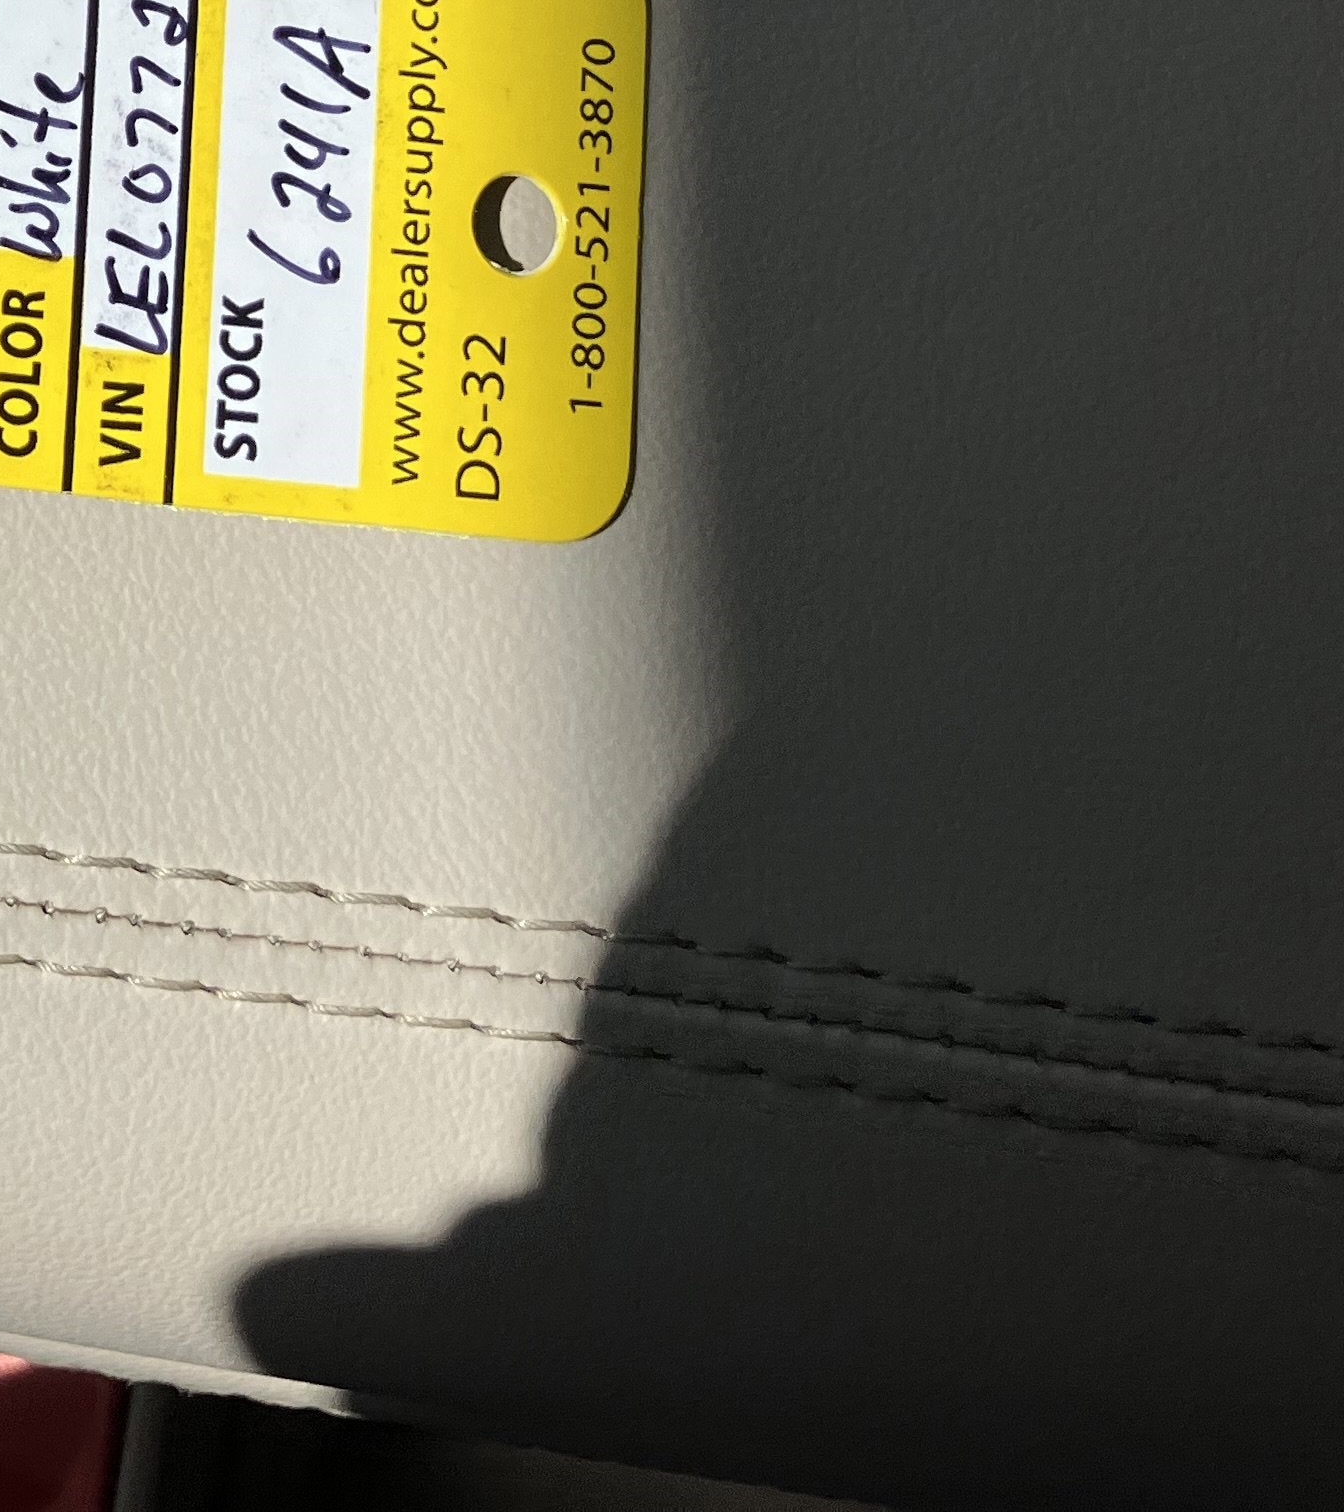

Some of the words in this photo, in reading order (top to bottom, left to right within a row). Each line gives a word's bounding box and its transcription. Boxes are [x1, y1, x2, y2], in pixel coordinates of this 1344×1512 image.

[246, 24, 372, 285] 6241A
[570, 38, 617, 414] 1-800-521-3870
[99, 381, 146, 467] VIN
[213, 294, 266, 463] STOCK
[456, 333, 507, 501] DS-32
